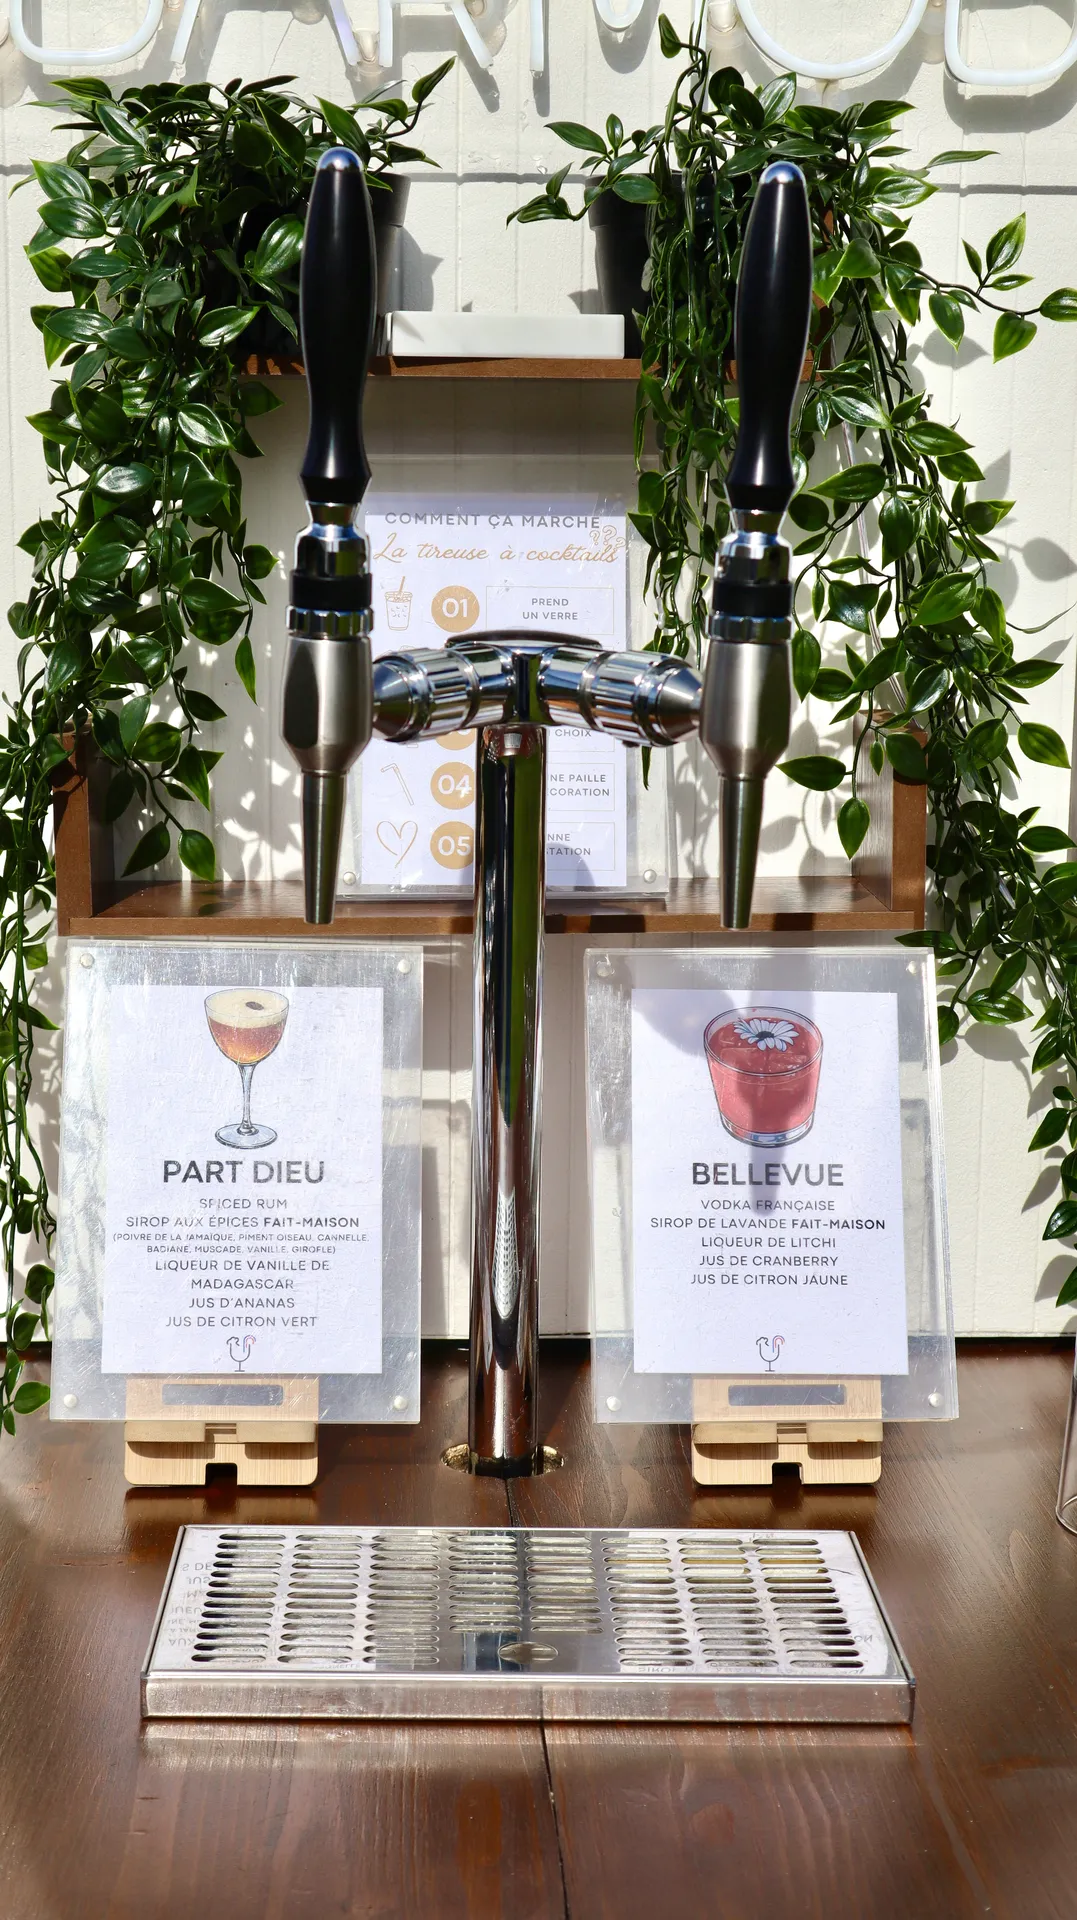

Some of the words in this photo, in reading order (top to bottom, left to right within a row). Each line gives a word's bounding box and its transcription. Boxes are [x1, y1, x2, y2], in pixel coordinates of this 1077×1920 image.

[385, 512, 480, 527] COMMENT
[488, 515, 514, 529] ÇA
[522, 516, 600, 529] MARCHE
[373, 532, 407, 563] La
[417, 543, 489, 560] tireuse
[499, 544, 516, 560] à
[526, 543, 619, 563] cocktails
[442, 598, 468, 618] 01
[531, 598, 569, 607] PREND
[523, 611, 540, 620] UN
[543, 611, 578, 620] VERRE
[555, 729, 591, 737] CHOIX
[550, 774, 564, 782] NE
[569, 775, 606, 783] PAILLE
[437, 774, 472, 798] 04
[547, 788, 610, 796] CORATION
[437, 836, 471, 856] 05
[163, 1160, 243, 1183] PART
[253, 1161, 325, 1184] DIEU
[692, 1162, 844, 1186] BELLEVUE
[200, 1198, 251, 1209] SPICED
[257, 1199, 287, 1209] RUM
[701, 1199, 751, 1210] VODKA
[756, 1200, 835, 1213] FRANÇAISE
[126, 1216, 170, 1227] SIROP
[174, 1217, 203, 1227] AUX
[208, 1214, 259, 1228] ÉPICES
[264, 1217, 359, 1228] FAIT-MAISON
[650, 1217, 693, 1228] SIROP
[699, 1218, 716, 1228] DE
[721, 1218, 787, 1229] LAVANDE
[792, 1219, 885, 1230] FAIT-MAISON
[113, 1233, 151, 1241] (POIVRE
[702, 1237, 762, 1249] LIQUEUR
[768, 1237, 786, 1248] DE
[791, 1238, 836, 1248] LITCHI
[292, 1246, 336, 1254] GIROFLE)
[156, 1260, 218, 1272] LIQUEUR
[224, 1261, 242, 1271] DE
[247, 1261, 305, 1271] VANILLE
[311, 1261, 329, 1271] DE
[700, 1256, 724, 1266] JUS
[730, 1256, 748, 1266] DE
[753, 1256, 838, 1267] CRANBERRY
[191, 1279, 294, 1289] MADAGASCAR
[691, 1274, 715, 1285] JUS
[721, 1274, 739, 1285] DE
[744, 1274, 798, 1286] CITRON
[802, 1274, 848, 1286] JAUNE
[189, 1298, 214, 1308] JUS
[166, 1317, 191, 1327] JUS
[197, 1317, 215, 1327] DE
[220, 1317, 276, 1327] CITRON
[281, 1317, 317, 1327] VERT
